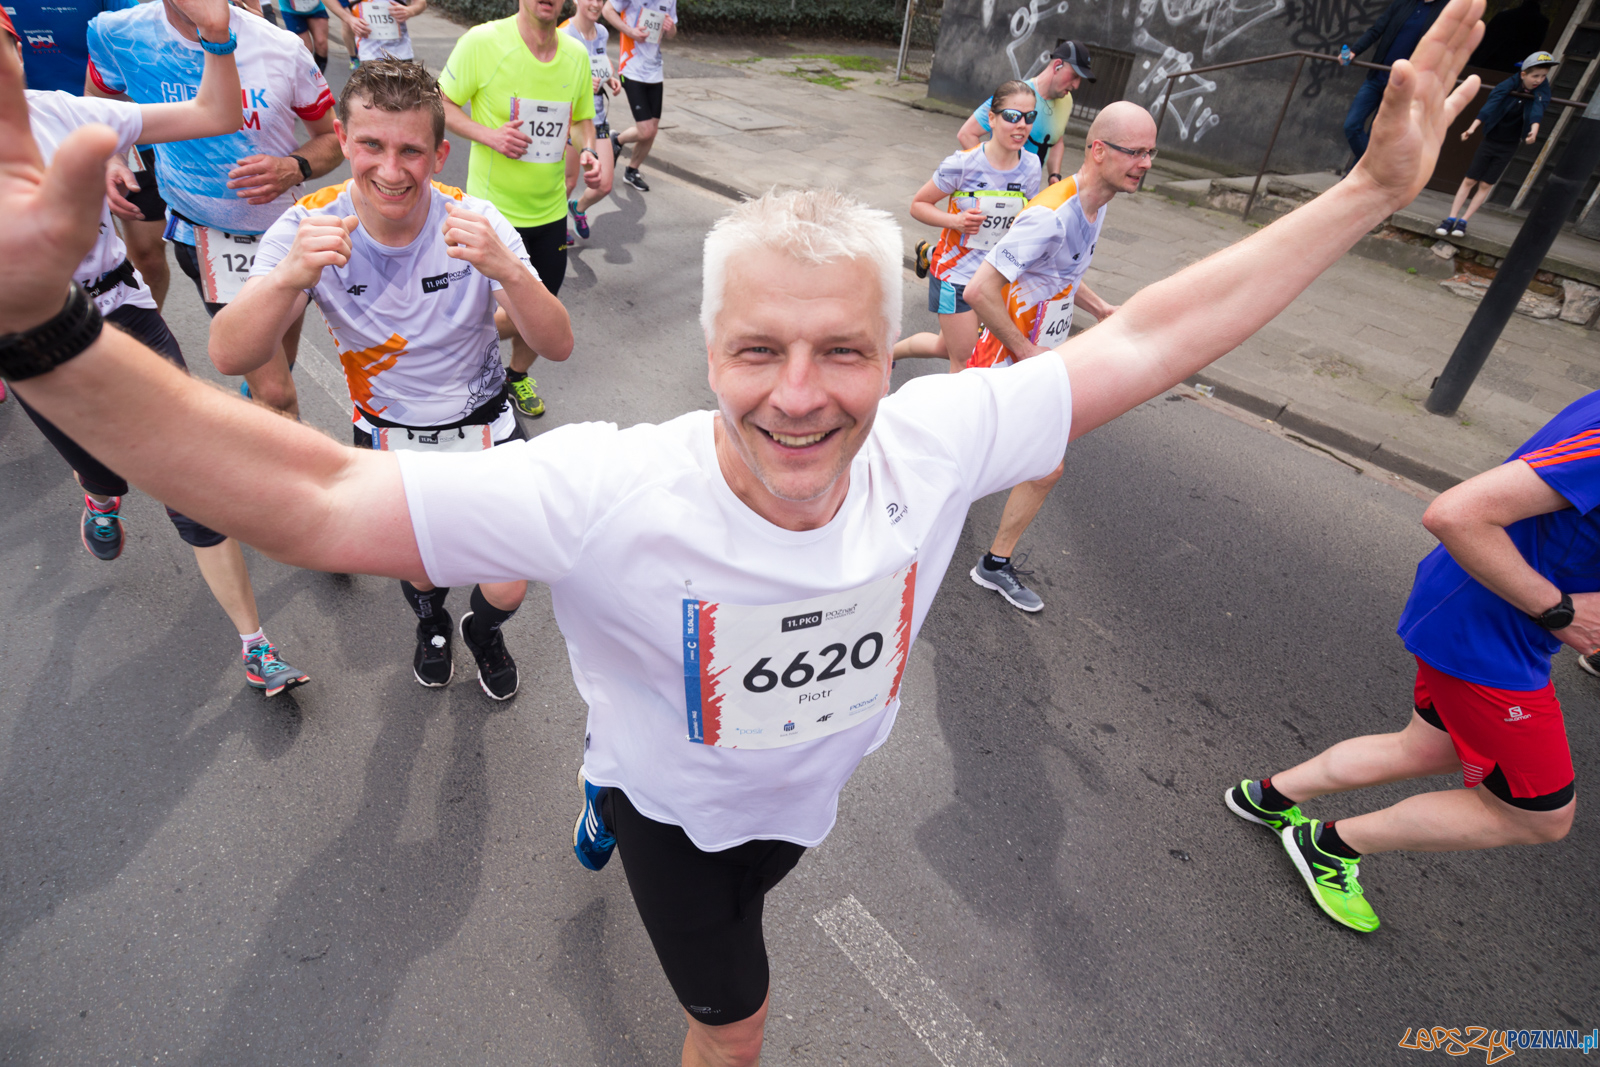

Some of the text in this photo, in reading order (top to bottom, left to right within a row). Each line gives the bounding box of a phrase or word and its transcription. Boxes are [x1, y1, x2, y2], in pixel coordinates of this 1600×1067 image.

[368, 14, 394, 24] 11135
[529, 120, 563, 137] 1627
[982, 215, 1015, 229] 5918
[426, 281, 435, 289] 11.
[435, 276, 448, 287] PKO
[687, 603, 695, 634] 15.04.2018
[787, 619, 798, 628] 11.
[799, 615, 819, 626] PKO
[687, 641, 697, 649] C
[743, 631, 883, 693] 6620
[798, 689, 833, 704] Piotr
